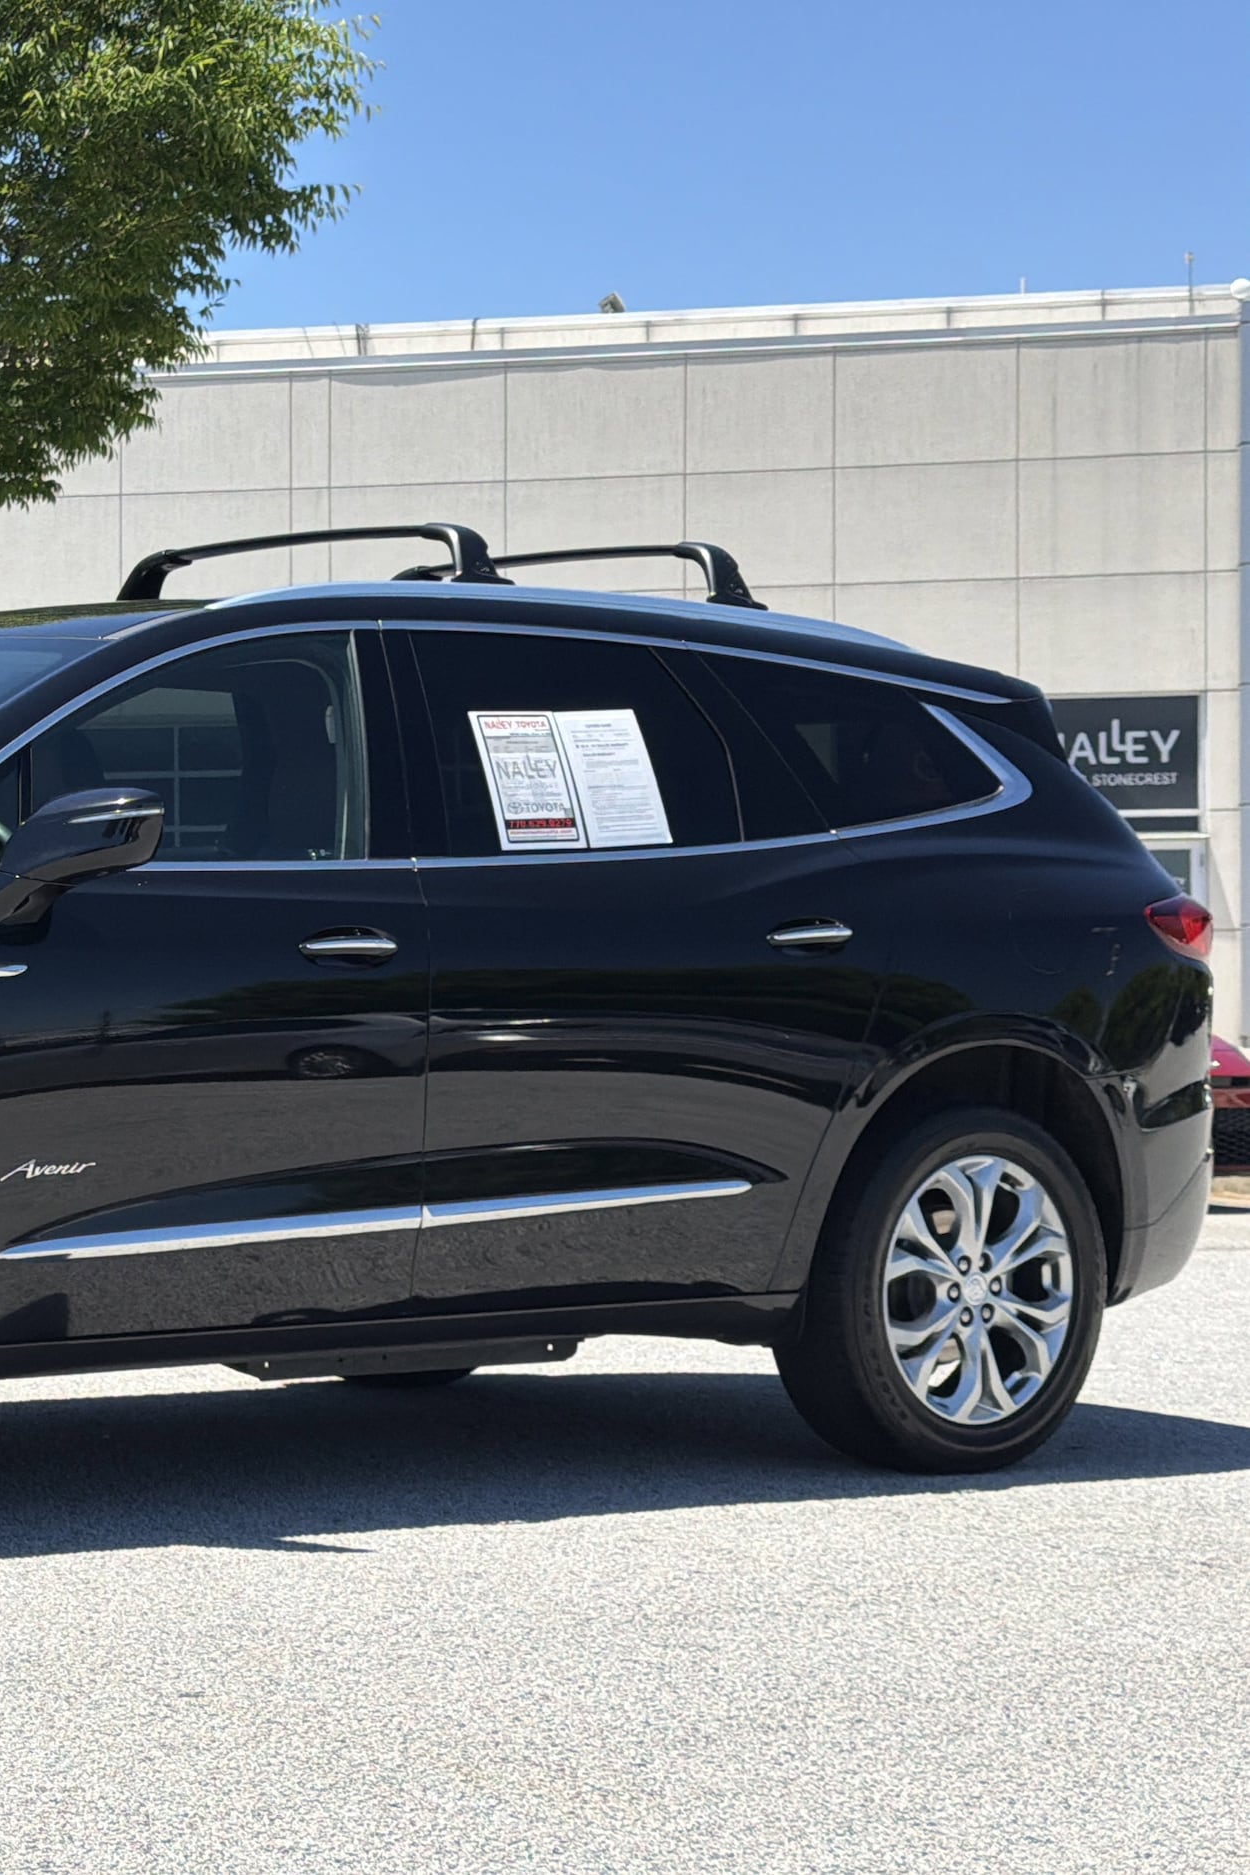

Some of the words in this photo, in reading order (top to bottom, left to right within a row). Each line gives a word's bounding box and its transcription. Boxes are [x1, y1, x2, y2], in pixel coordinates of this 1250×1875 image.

[484, 719, 512, 730] NALLEY
[515, 721, 547, 729] TOYOTA
[495, 754, 557, 780] NALLEY
[1091, 772, 1178, 787] STONECREST
[523, 802, 565, 814] TOYOTA
[0, 1159, 96, 1182] Avenir
